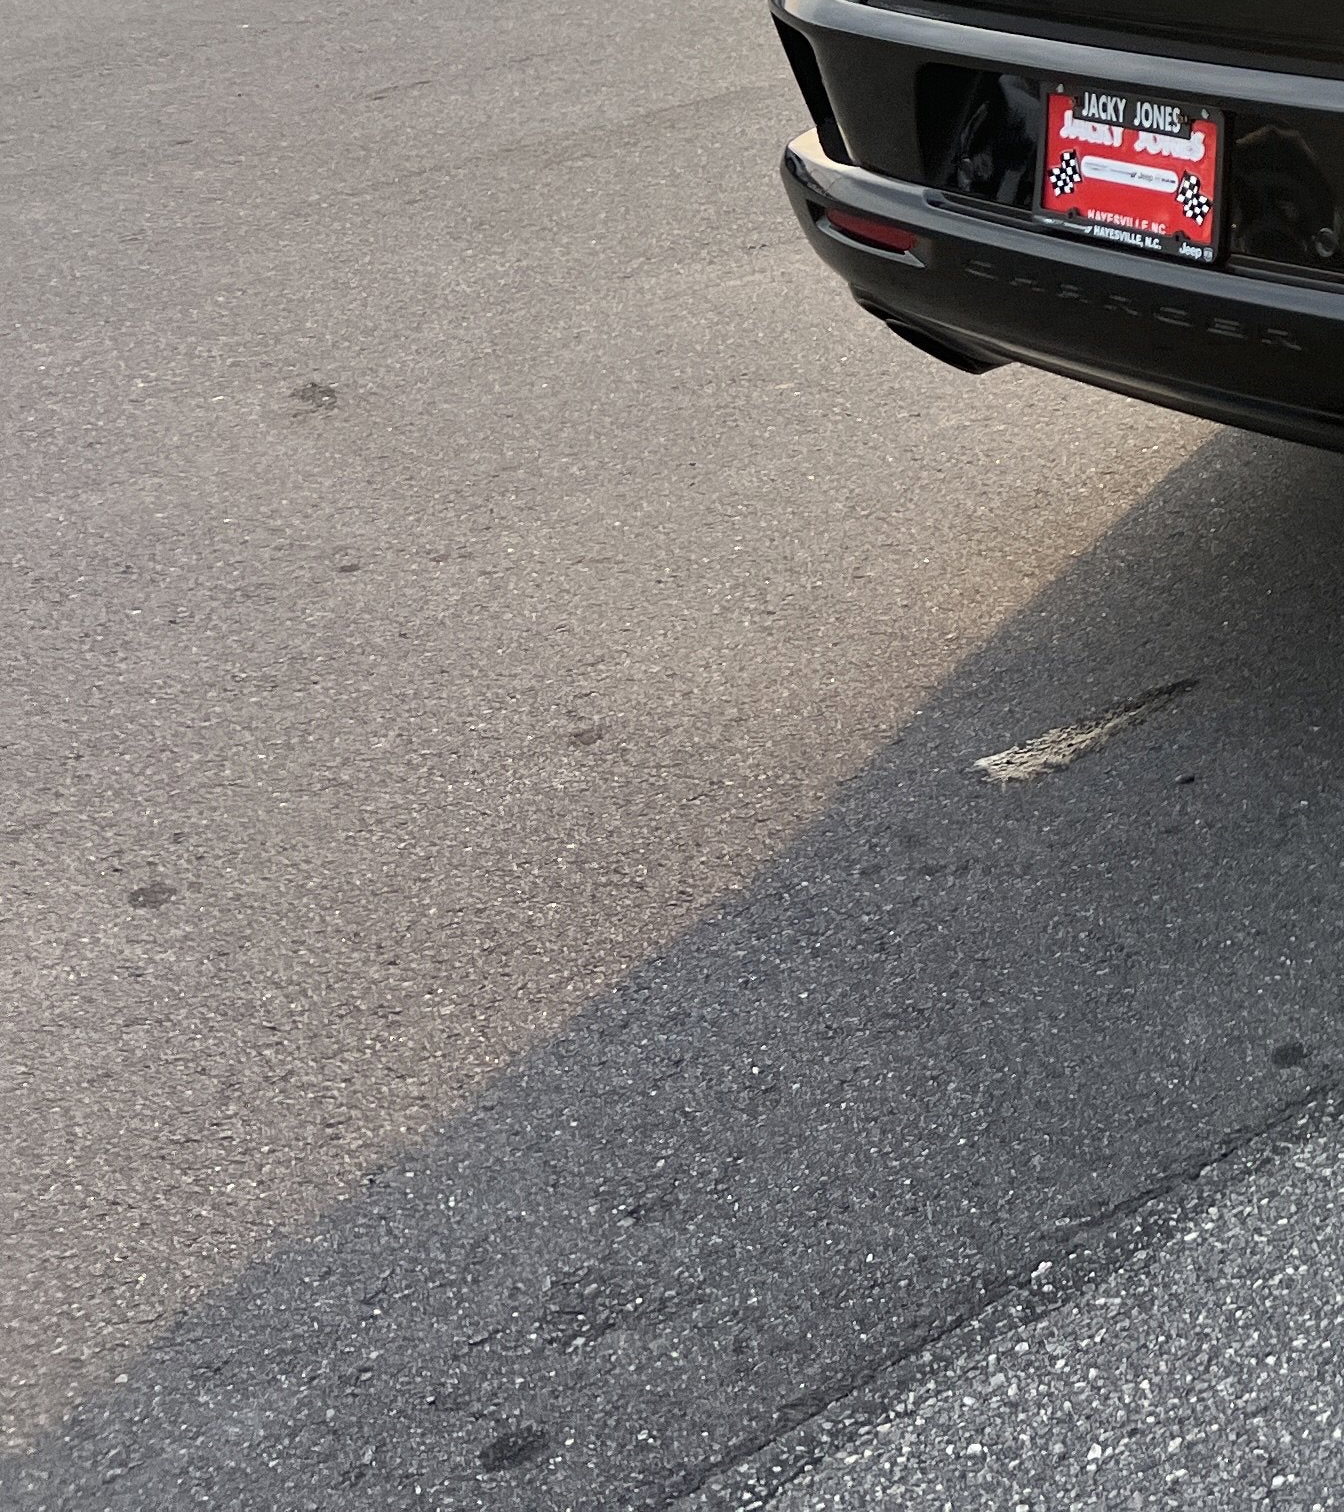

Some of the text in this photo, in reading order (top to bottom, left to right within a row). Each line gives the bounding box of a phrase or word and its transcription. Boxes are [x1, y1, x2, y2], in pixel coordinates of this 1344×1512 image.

[1081, 91, 1181, 133] JACKY JONES
[1179, 242, 1203, 259] Jeep
